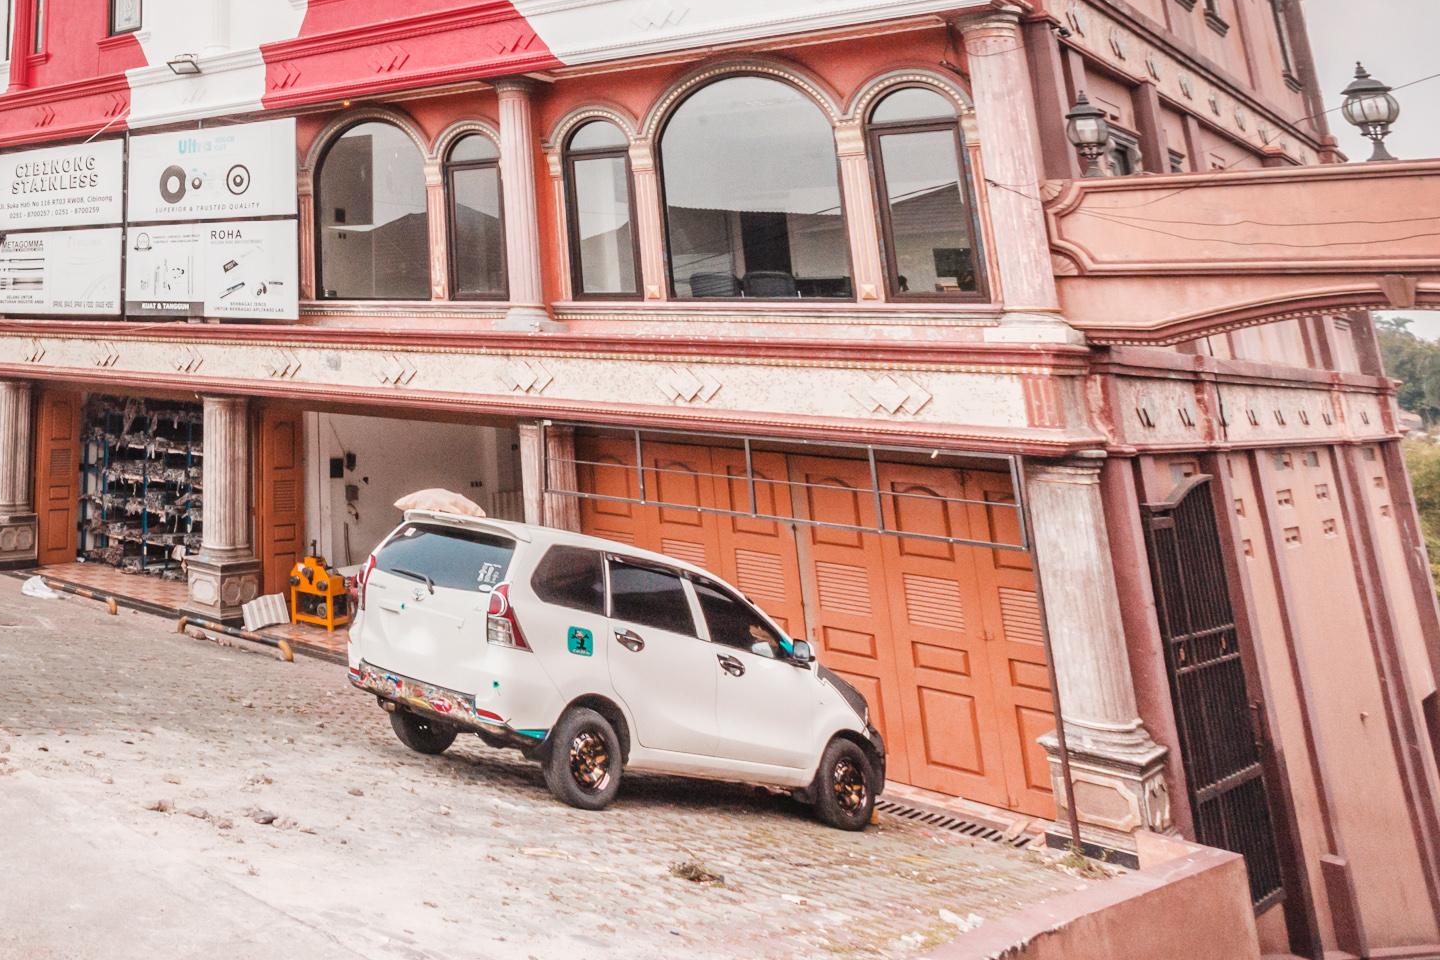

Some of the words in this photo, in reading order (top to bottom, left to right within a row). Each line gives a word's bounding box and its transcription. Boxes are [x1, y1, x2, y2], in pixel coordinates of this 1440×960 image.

[178, 138, 213, 155] Ultra
[15, 155, 97, 179] CIBINONG
[12, 172, 99, 195] STAINLESS
[32, 200, 40, 208] No
[41, 199, 51, 207] 116
[87, 195, 113, 203] Cibinong
[155, 205, 188, 214] SUPERIOR
[196, 203, 227, 212] TRUSTED
[229, 201, 261, 211] QUALITY
[55, 208, 69, 216] 0251
[210, 228, 242, 240] ROHA
[2, 240, 44, 249] METAGOMMA
[142, 302, 156, 310] KUAT
